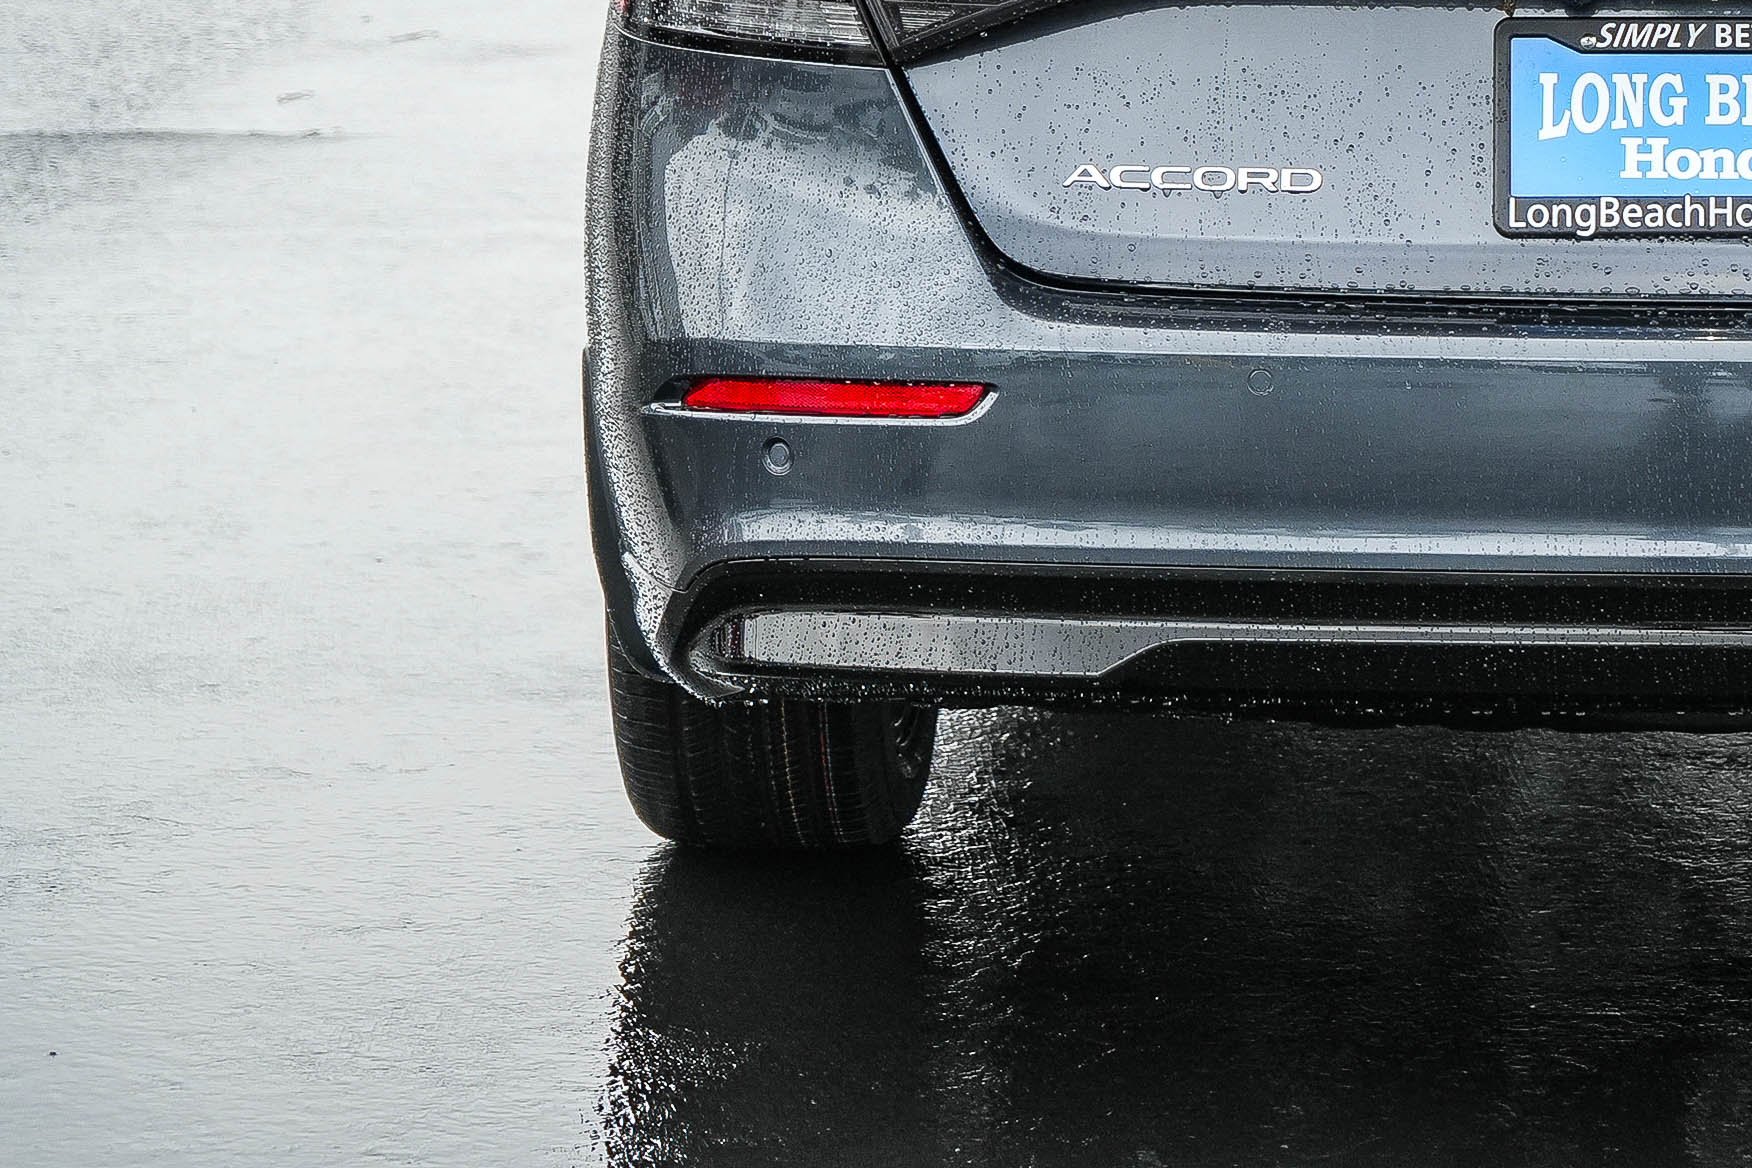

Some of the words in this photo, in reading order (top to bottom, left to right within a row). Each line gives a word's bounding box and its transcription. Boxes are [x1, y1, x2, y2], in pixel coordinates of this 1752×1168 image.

[1596, 22, 1706, 49] SIMPLY
[1538, 72, 1689, 141] LONG
[1062, 164, 1324, 193] ACCORD
